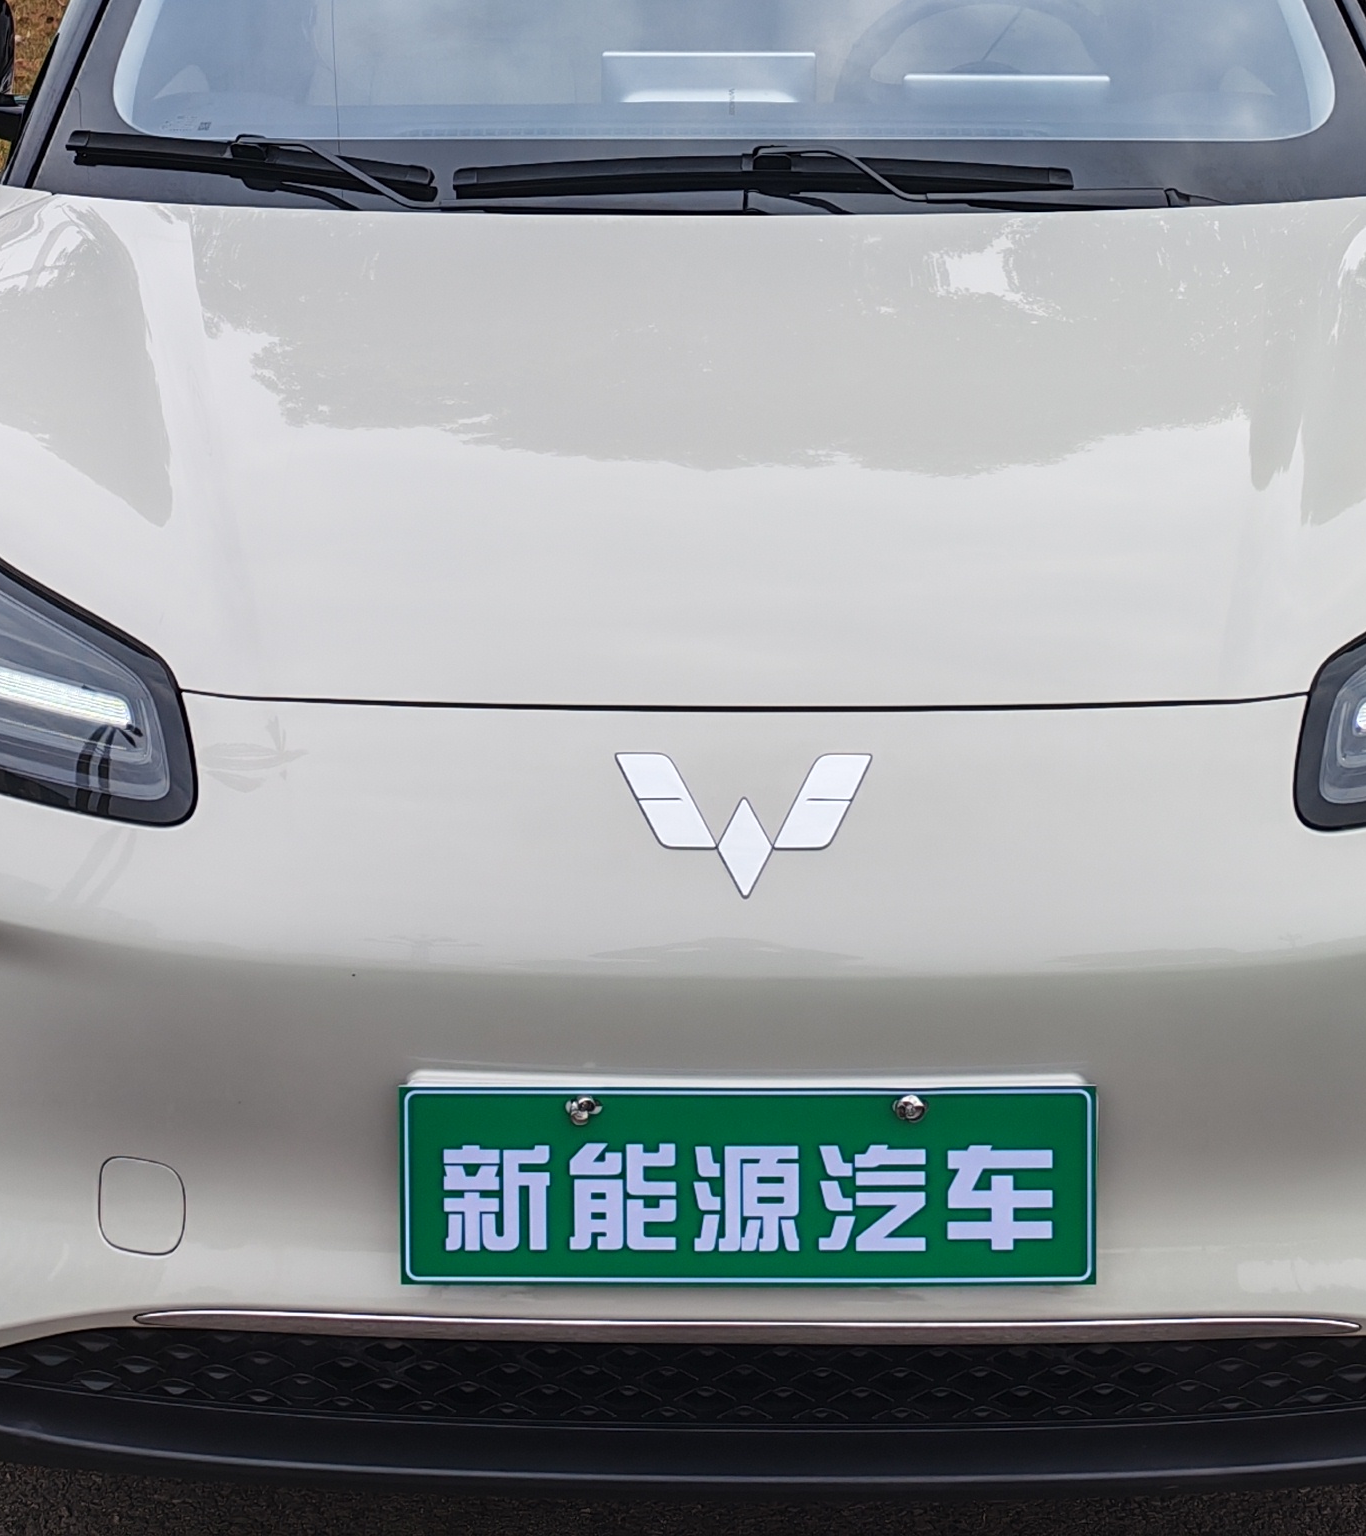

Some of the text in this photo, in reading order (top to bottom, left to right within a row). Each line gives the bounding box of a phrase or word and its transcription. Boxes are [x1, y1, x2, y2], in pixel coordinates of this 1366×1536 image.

[442, 1142, 1054, 1252] 新能源汽车
